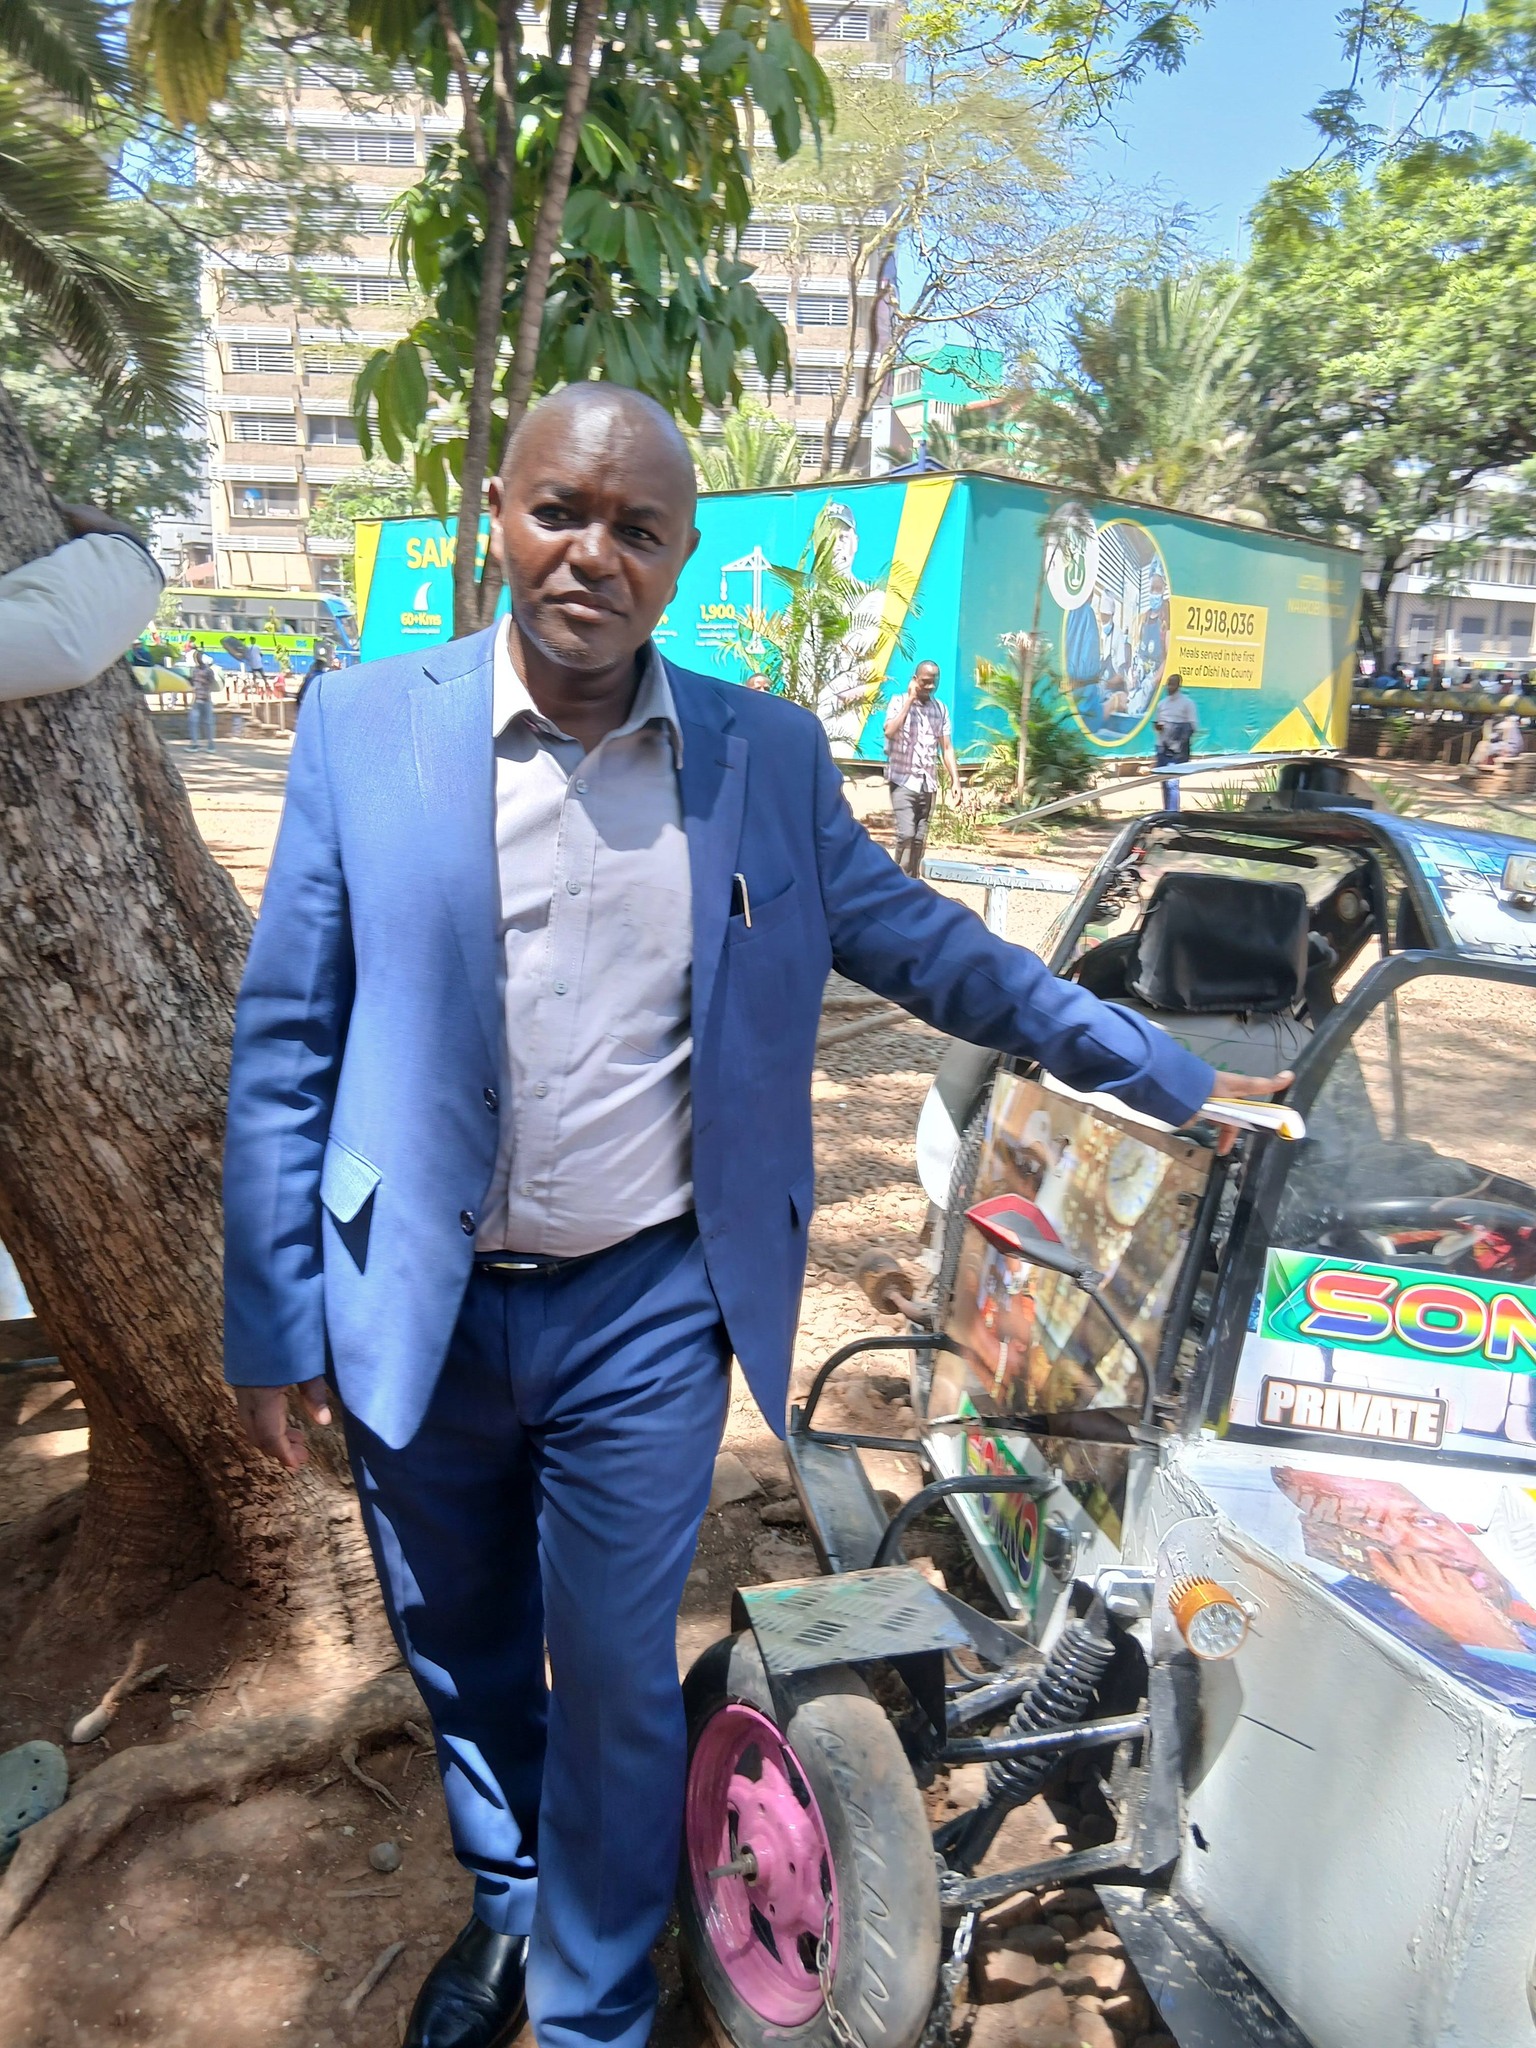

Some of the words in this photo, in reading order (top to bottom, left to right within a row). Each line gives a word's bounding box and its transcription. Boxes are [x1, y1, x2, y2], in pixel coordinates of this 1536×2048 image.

[700, 604, 735, 622] 1,900
[1186, 606, 1255, 638] 21,918,036
[1180, 646, 1200, 659] Meals
[1200, 649, 1223, 661] served
[1224, 649, 1230, 661] in
[1231, 650, 1241, 662] the
[1243, 651, 1255, 663] first
[1178, 666, 1194, 677] year
[1194, 665, 1203, 677] of
[1203, 665, 1220, 678] Dishi
[1220, 667, 1230, 678] Na
[1231, 667, 1253, 682] County
[1263, 1380, 1442, 1444] PRIVATE
